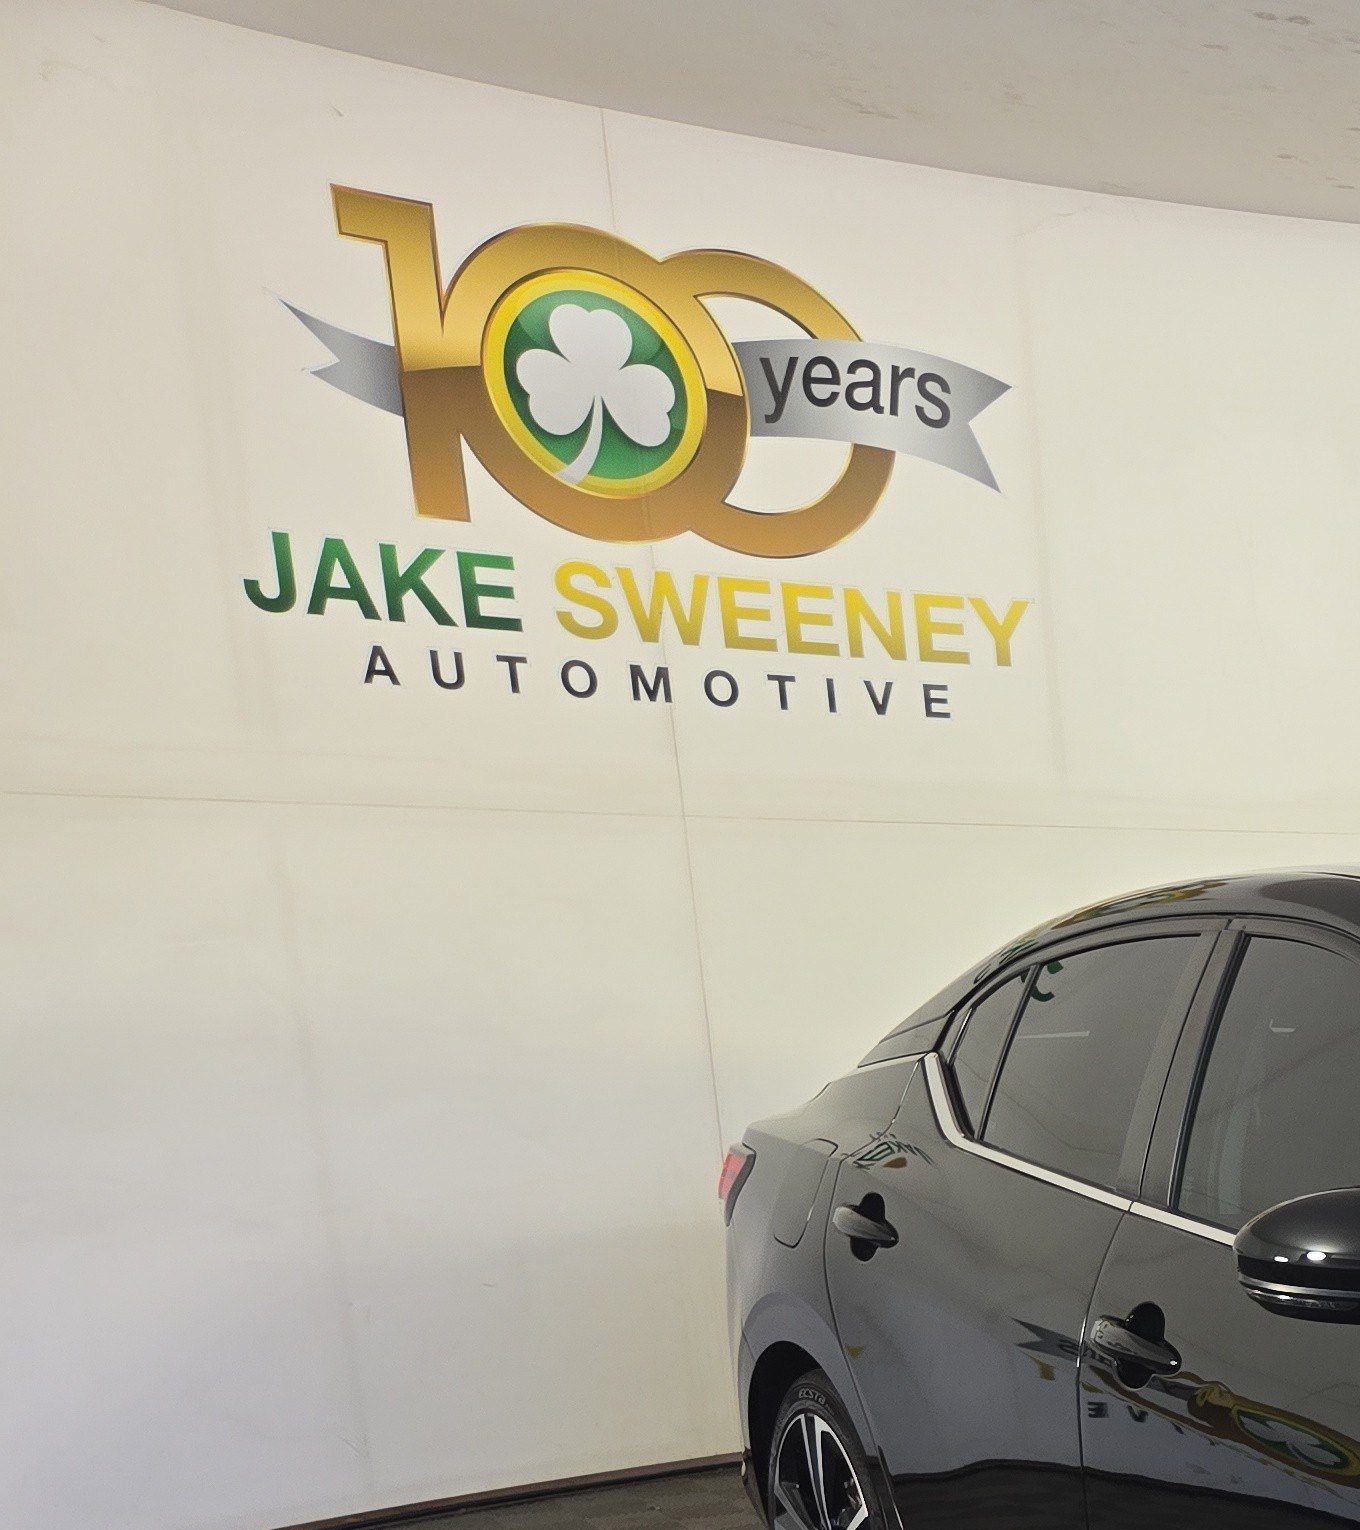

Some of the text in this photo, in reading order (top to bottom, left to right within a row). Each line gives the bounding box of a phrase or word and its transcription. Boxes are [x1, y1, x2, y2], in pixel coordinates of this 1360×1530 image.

[330, 183, 953, 559] 100 years
[243, 530, 1029, 668] JAKE SWEENEY
[363, 644, 952, 719] AUTOMOTIVE
